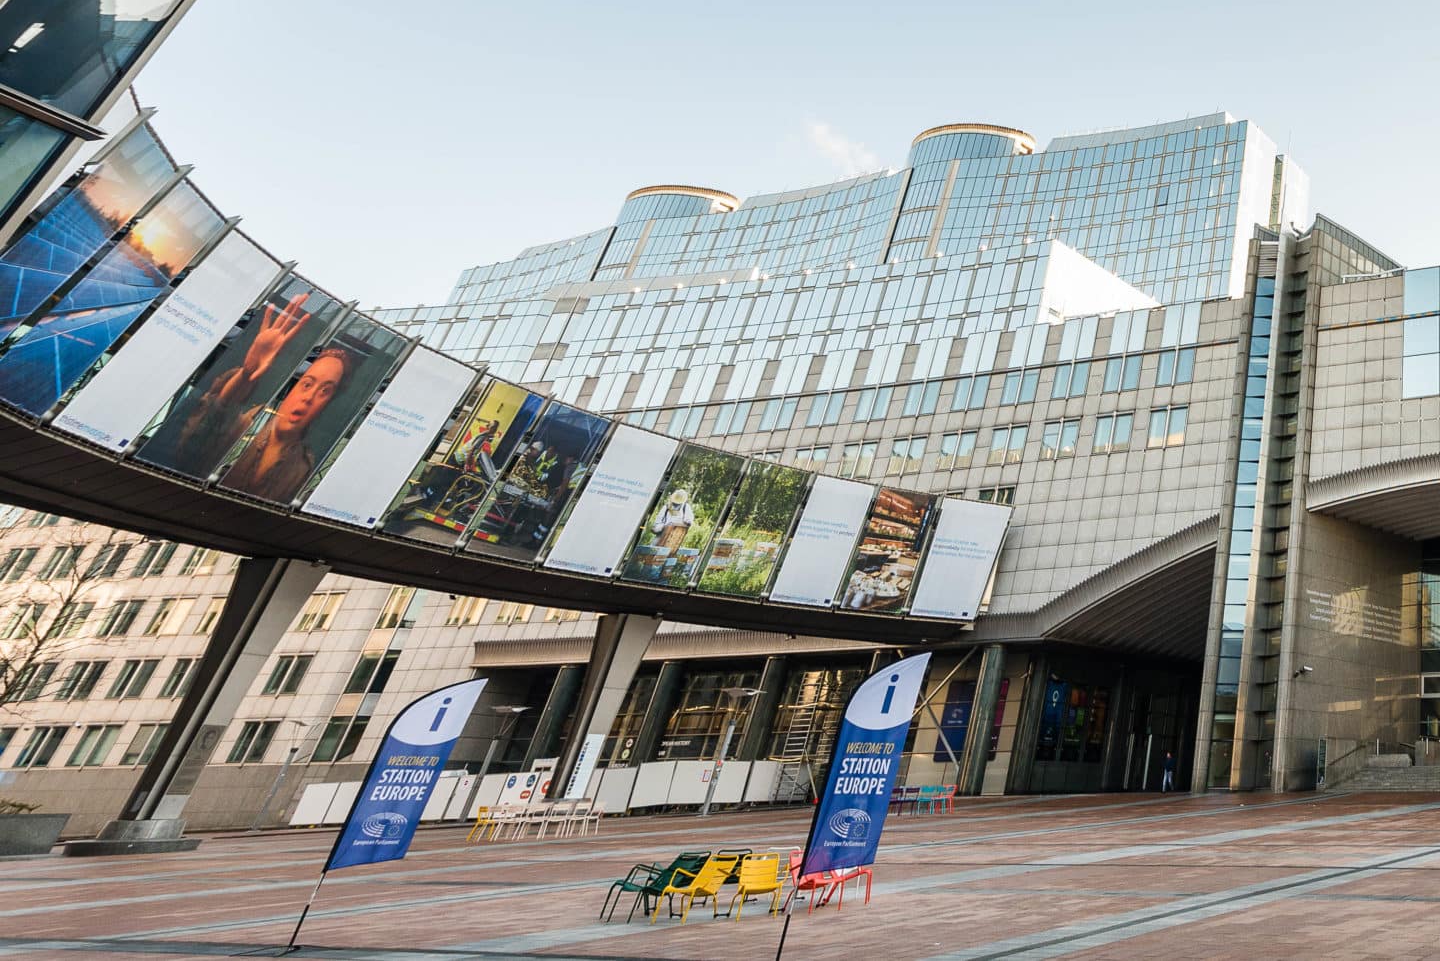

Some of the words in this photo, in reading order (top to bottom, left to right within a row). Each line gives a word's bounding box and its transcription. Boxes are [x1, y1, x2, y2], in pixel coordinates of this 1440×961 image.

[845, 742, 884, 755] WELCOME
[883, 742, 895, 755] TO
[387, 755, 427, 767] WELCOME
[428, 756, 440, 766] TO
[840, 758, 891, 775] STATION
[378, 769, 435, 784] STATION
[370, 785, 427, 801] EUROPE
[834, 778, 886, 795] EUROPE
